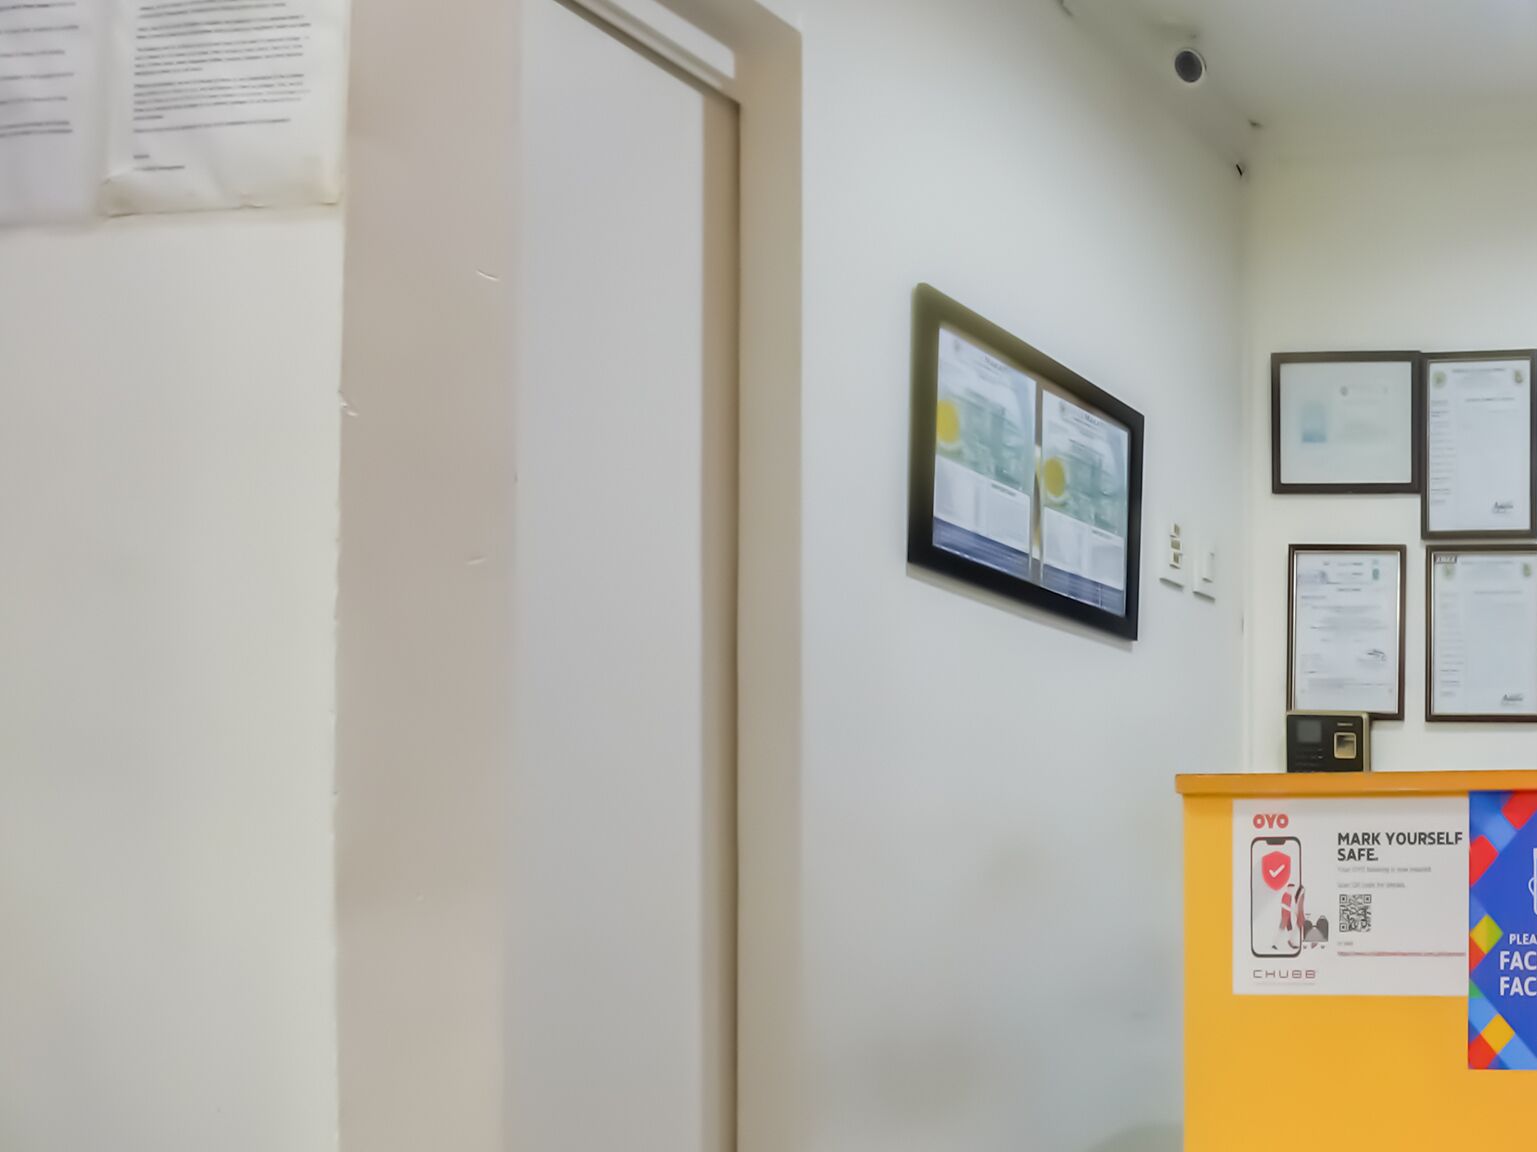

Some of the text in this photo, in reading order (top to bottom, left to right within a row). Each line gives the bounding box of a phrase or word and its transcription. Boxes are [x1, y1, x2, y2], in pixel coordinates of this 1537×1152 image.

[1253, 813, 1289, 829] OYO
[1337, 831, 1463, 846] MARK YOURSELF
[1337, 848, 1378, 862] SAFE.
[1252, 969, 1316, 979] CHUBB
